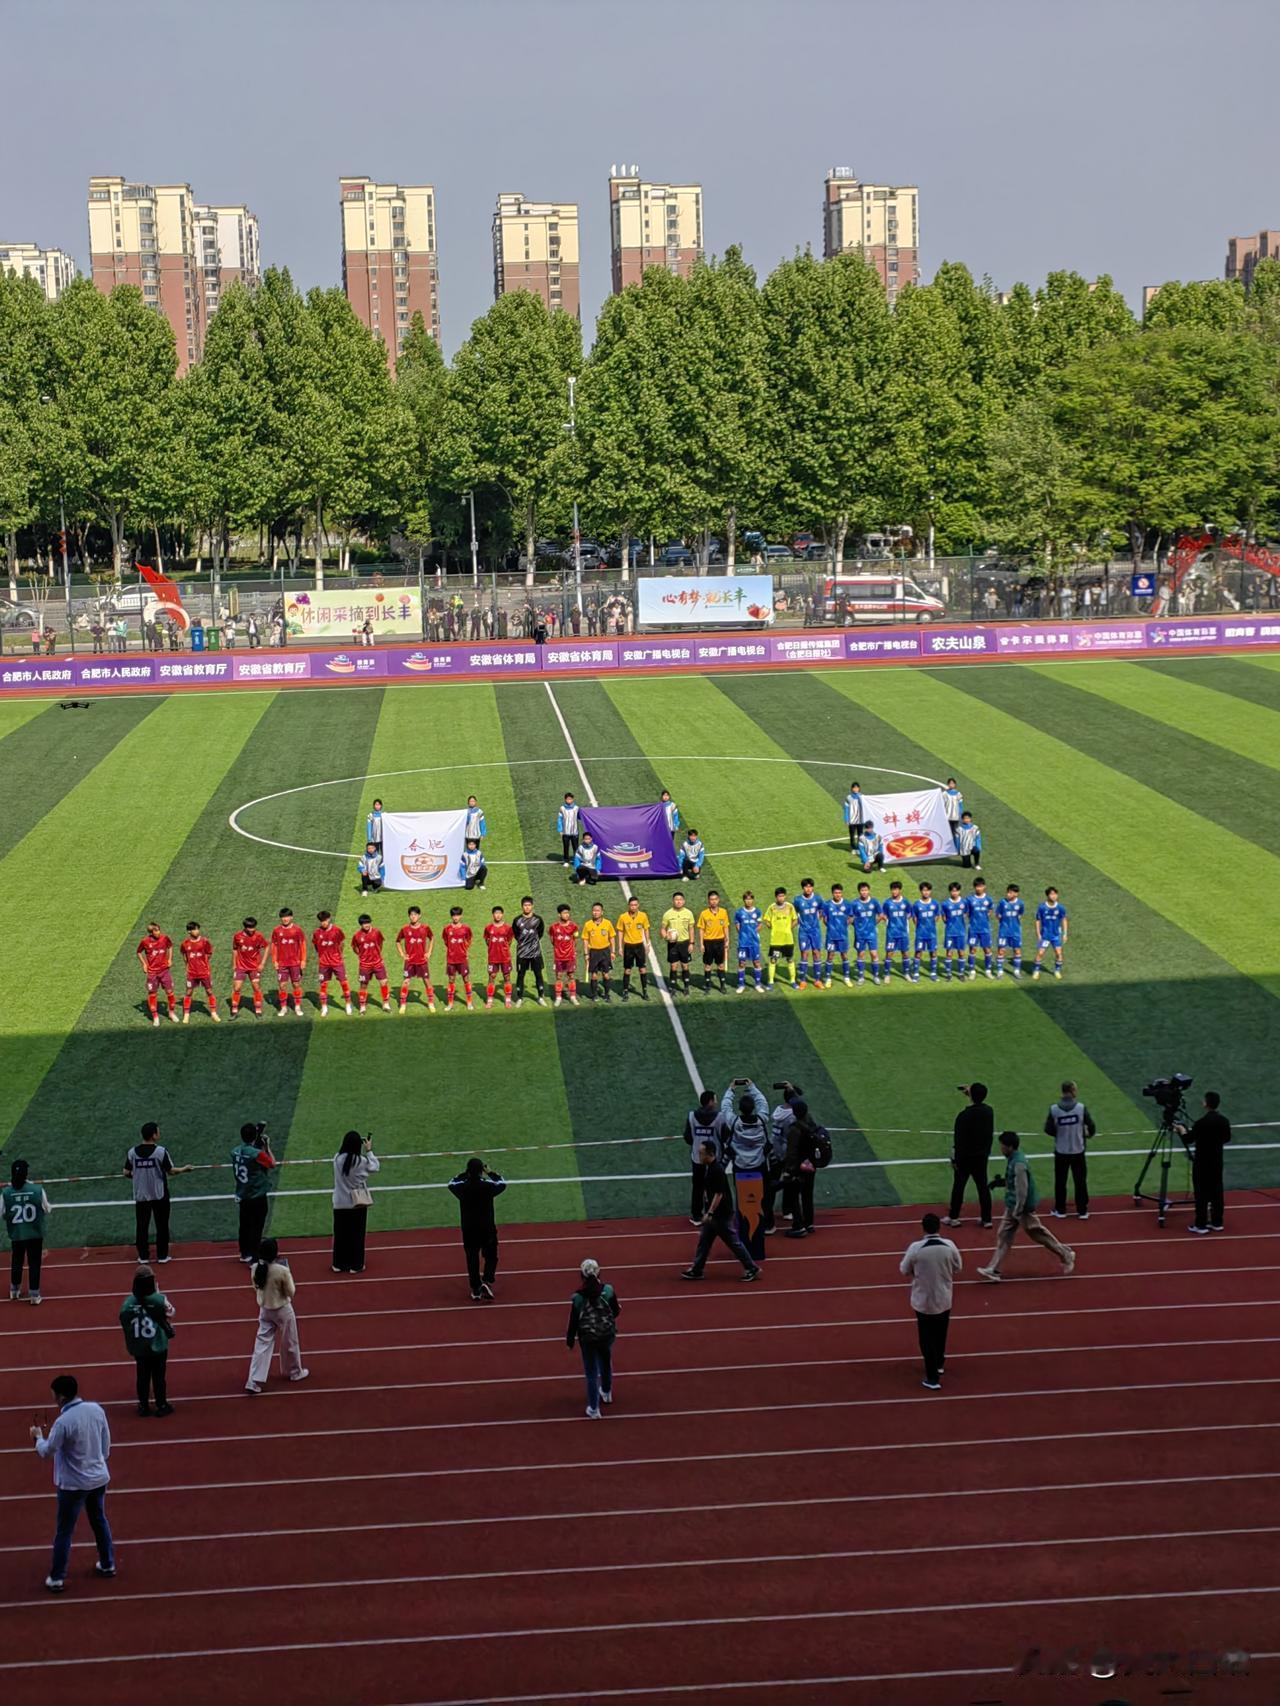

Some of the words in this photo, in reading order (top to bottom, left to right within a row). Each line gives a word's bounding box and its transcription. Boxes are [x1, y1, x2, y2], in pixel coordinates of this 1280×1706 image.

[300, 603, 412, 625] 休闲采摘到长丰
[849, 639, 918, 652] 合肥市广播电视台
[931, 635, 987, 650] 农夫山泉
[548, 649, 613, 663] 安徽省体育局
[623, 648, 691, 661] 安徽广播电视台
[699, 645, 765, 658] 安徽广播电视台
[470, 652, 536, 667] 安徽省体育局
[81, 665, 151, 680] 合肥市人民政府
[159, 663, 228, 677] 安徽省教育厅
[239, 660, 306, 675] 安徽省教育厅
[2, 669, 72, 683] 合肥市人民政府
[881, 809, 924, 827] 蚌埠
[234, 1163, 249, 1184] 13
[10, 1203, 37, 1224] 20
[130, 1316, 157, 1339] 18
